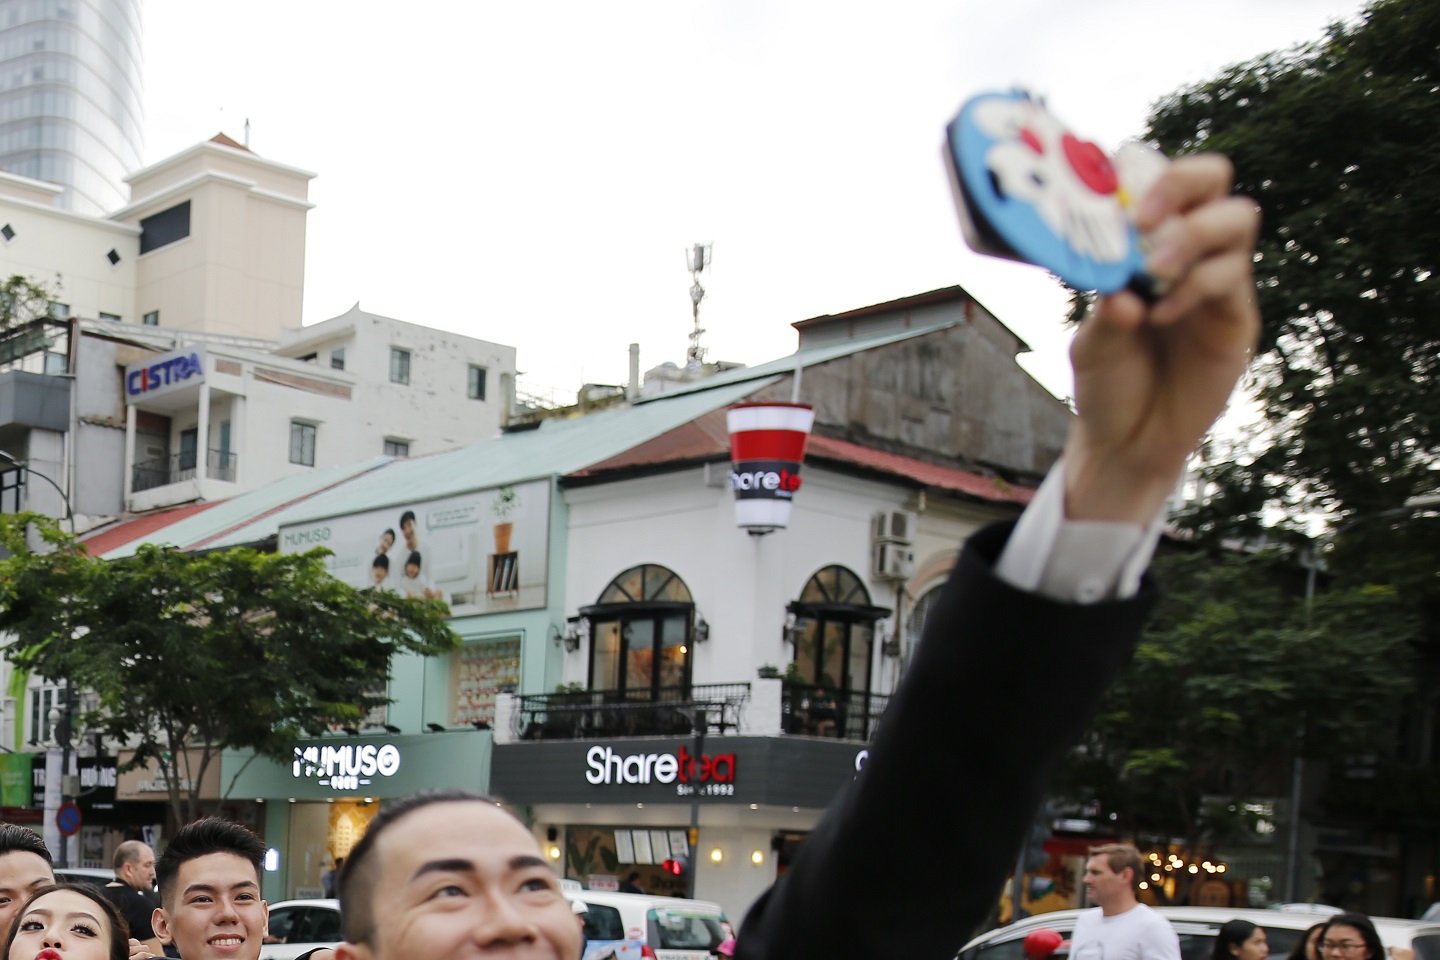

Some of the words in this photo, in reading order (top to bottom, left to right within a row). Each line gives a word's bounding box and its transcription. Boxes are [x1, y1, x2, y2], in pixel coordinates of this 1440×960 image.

[128, 353, 203, 395] CISTRA
[285, 527, 331, 546] MUMUSO
[586, 745, 735, 784] Sharetea
[707, 784, 734, 796] 1992
